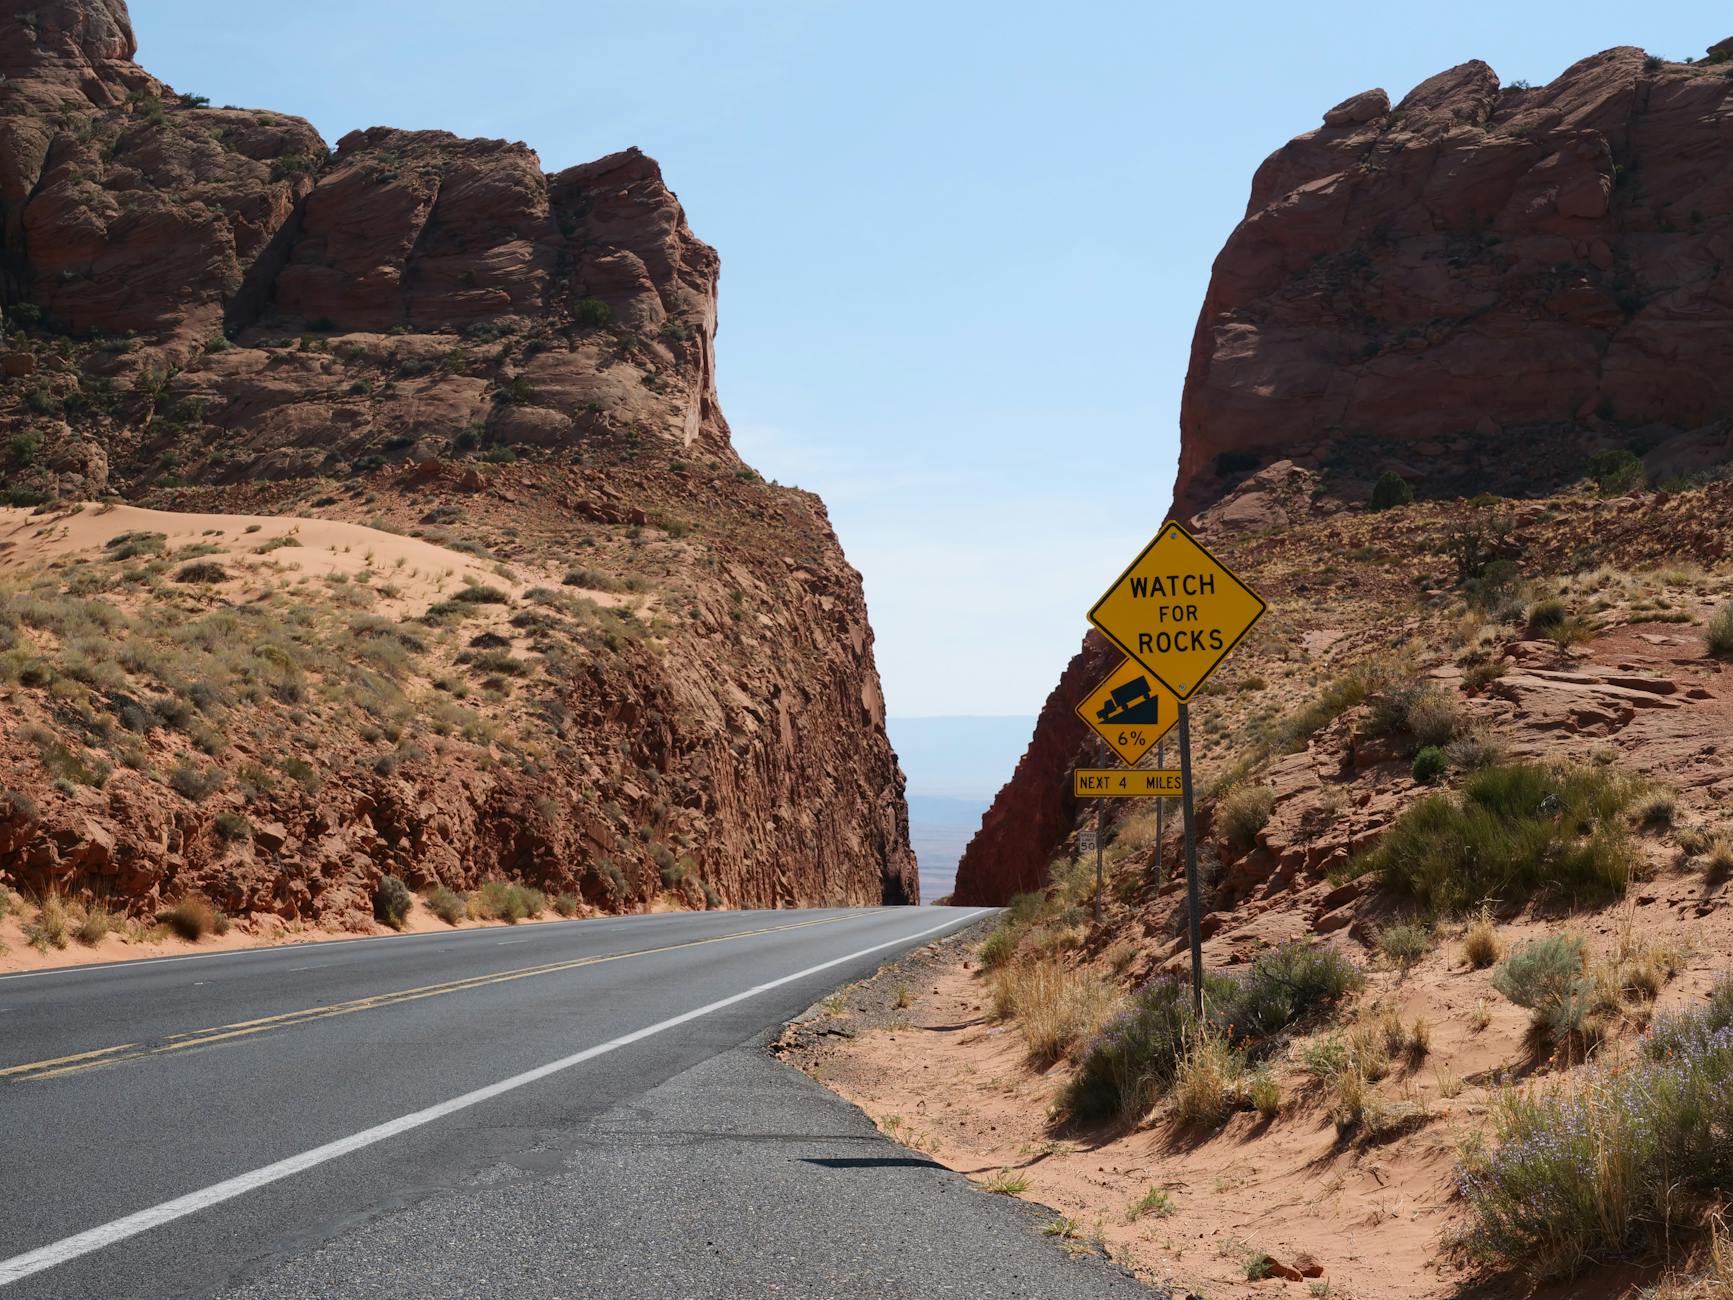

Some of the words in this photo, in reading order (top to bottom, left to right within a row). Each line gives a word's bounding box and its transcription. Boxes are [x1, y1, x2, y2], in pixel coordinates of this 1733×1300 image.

[1130, 574, 1215, 598] WATCH
[1159, 605, 1198, 623] FOR
[1138, 629, 1223, 654] ROCKS
[1118, 731, 1146, 746] 6%
[1080, 777, 1110, 789] NEXT
[1118, 777, 1127, 789] 4
[1146, 777, 1182, 789] MILES
[1081, 842, 1095, 850] 50
